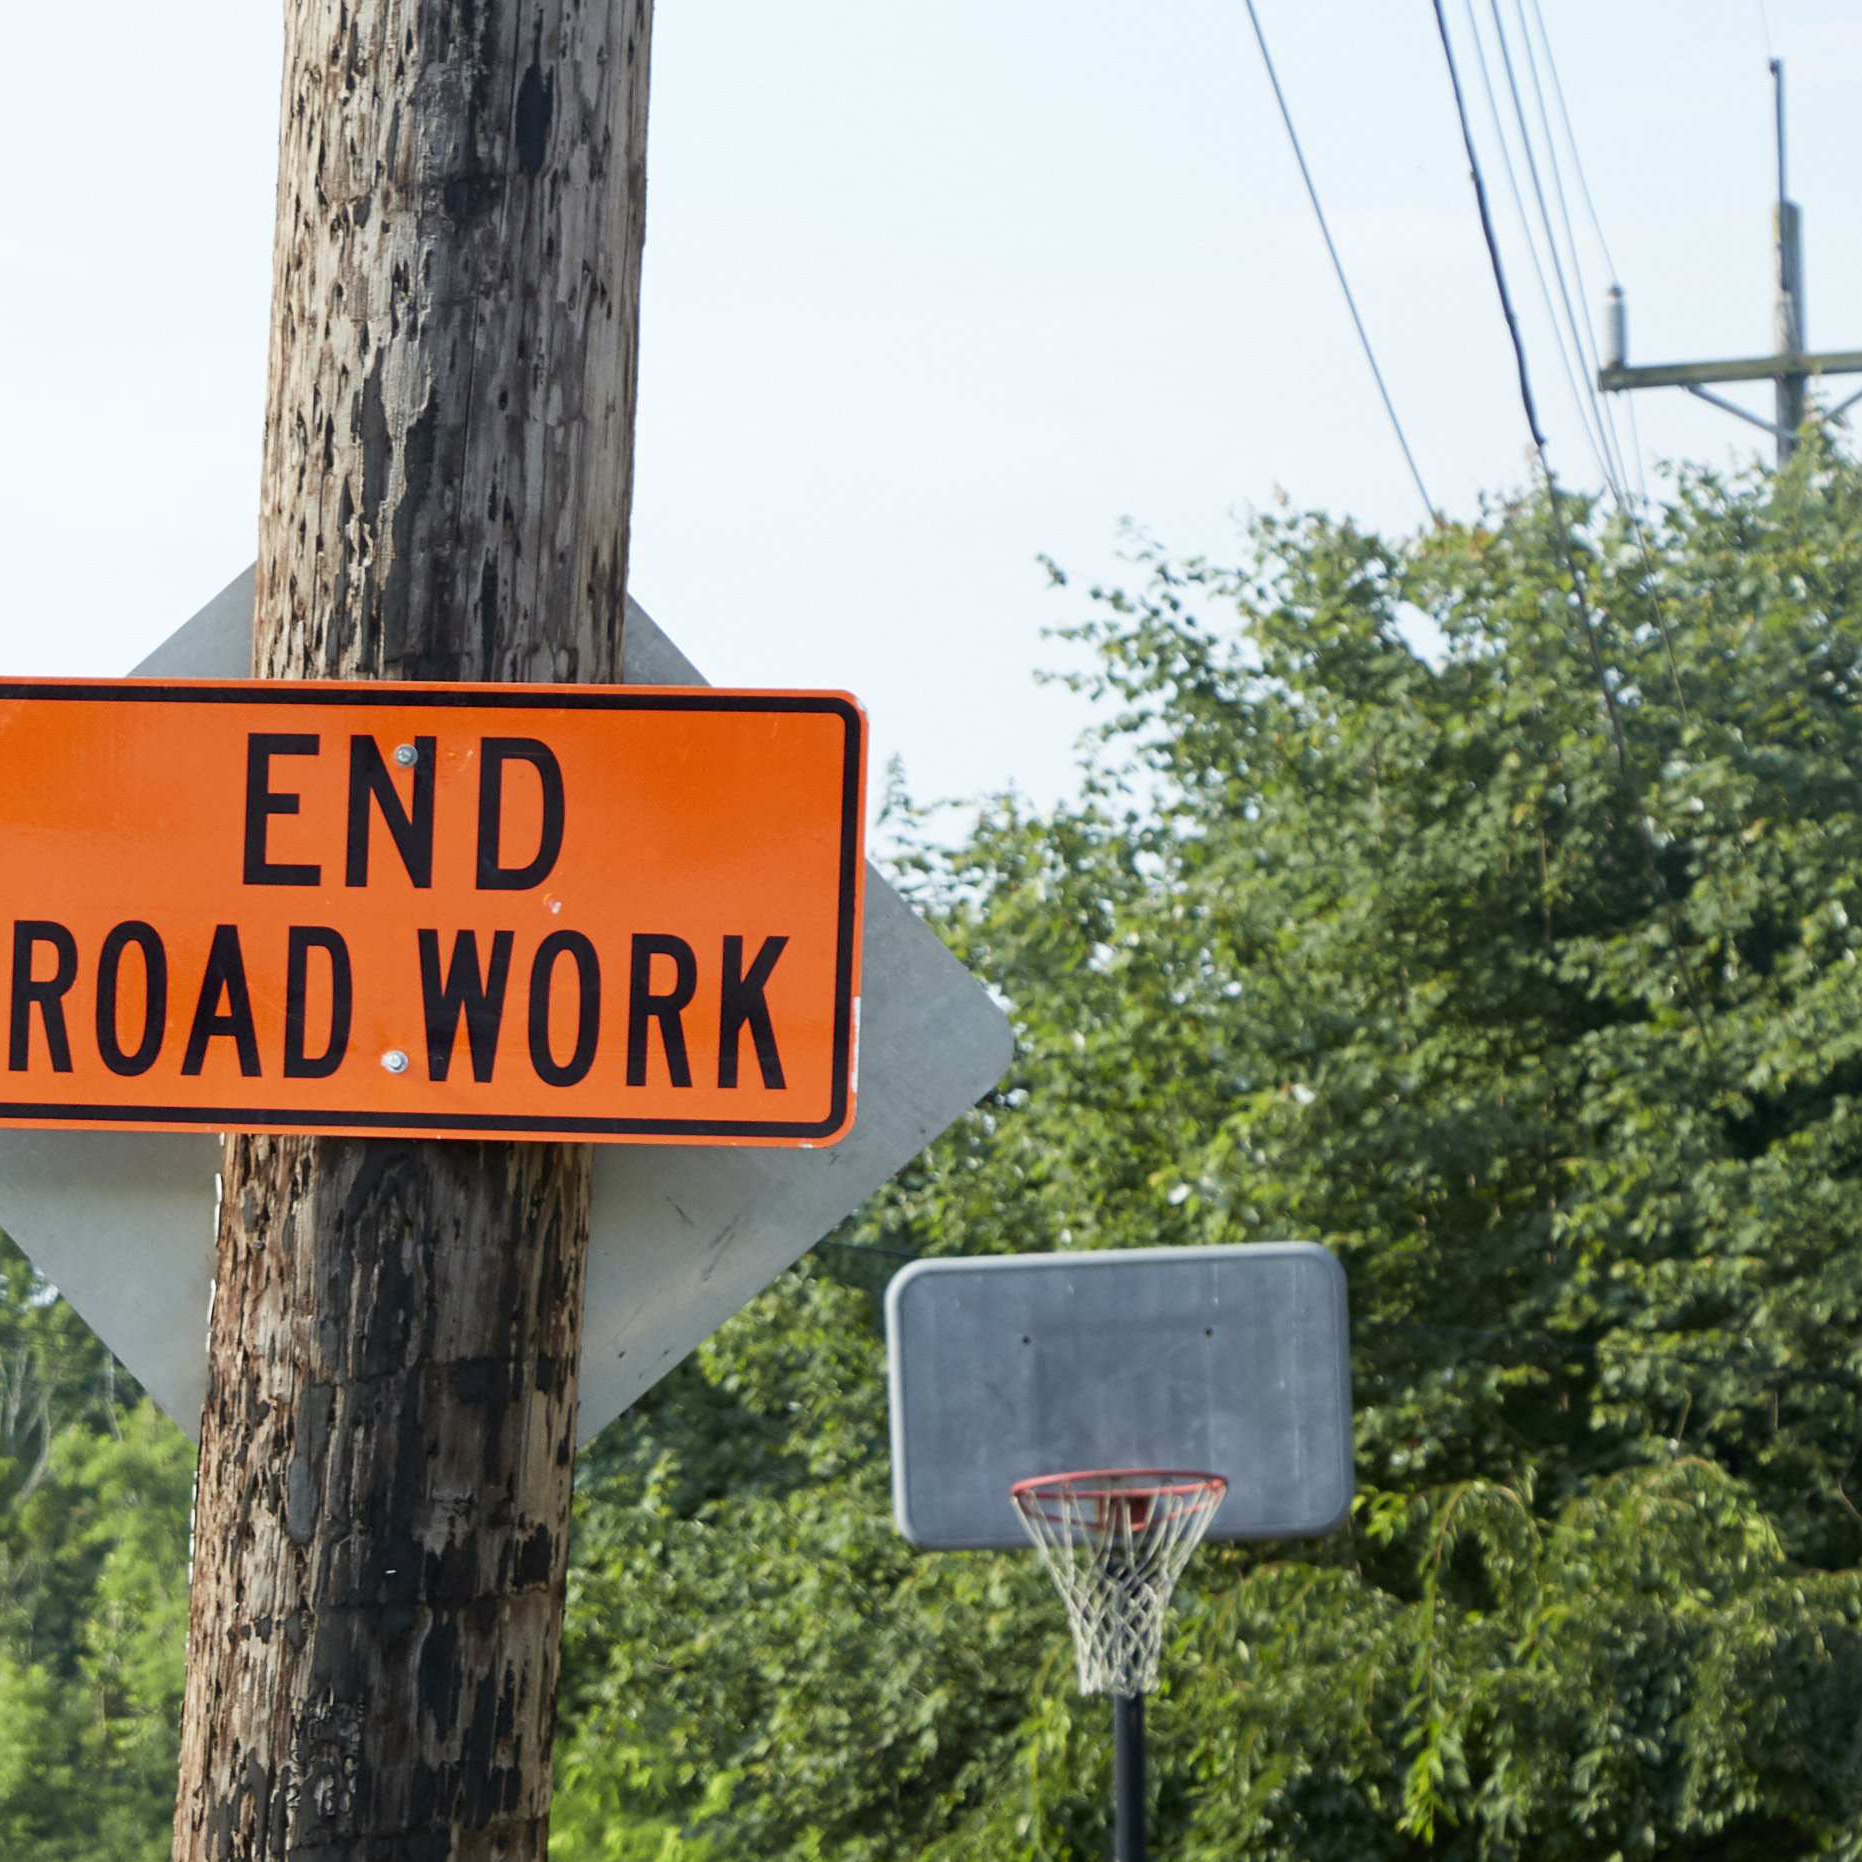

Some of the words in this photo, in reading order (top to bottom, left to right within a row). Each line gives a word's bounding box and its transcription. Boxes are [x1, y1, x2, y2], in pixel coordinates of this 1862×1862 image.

[242, 732, 565, 891] END
[8, 919, 353, 1079] ROAD
[417, 928, 789, 1090] WORK
